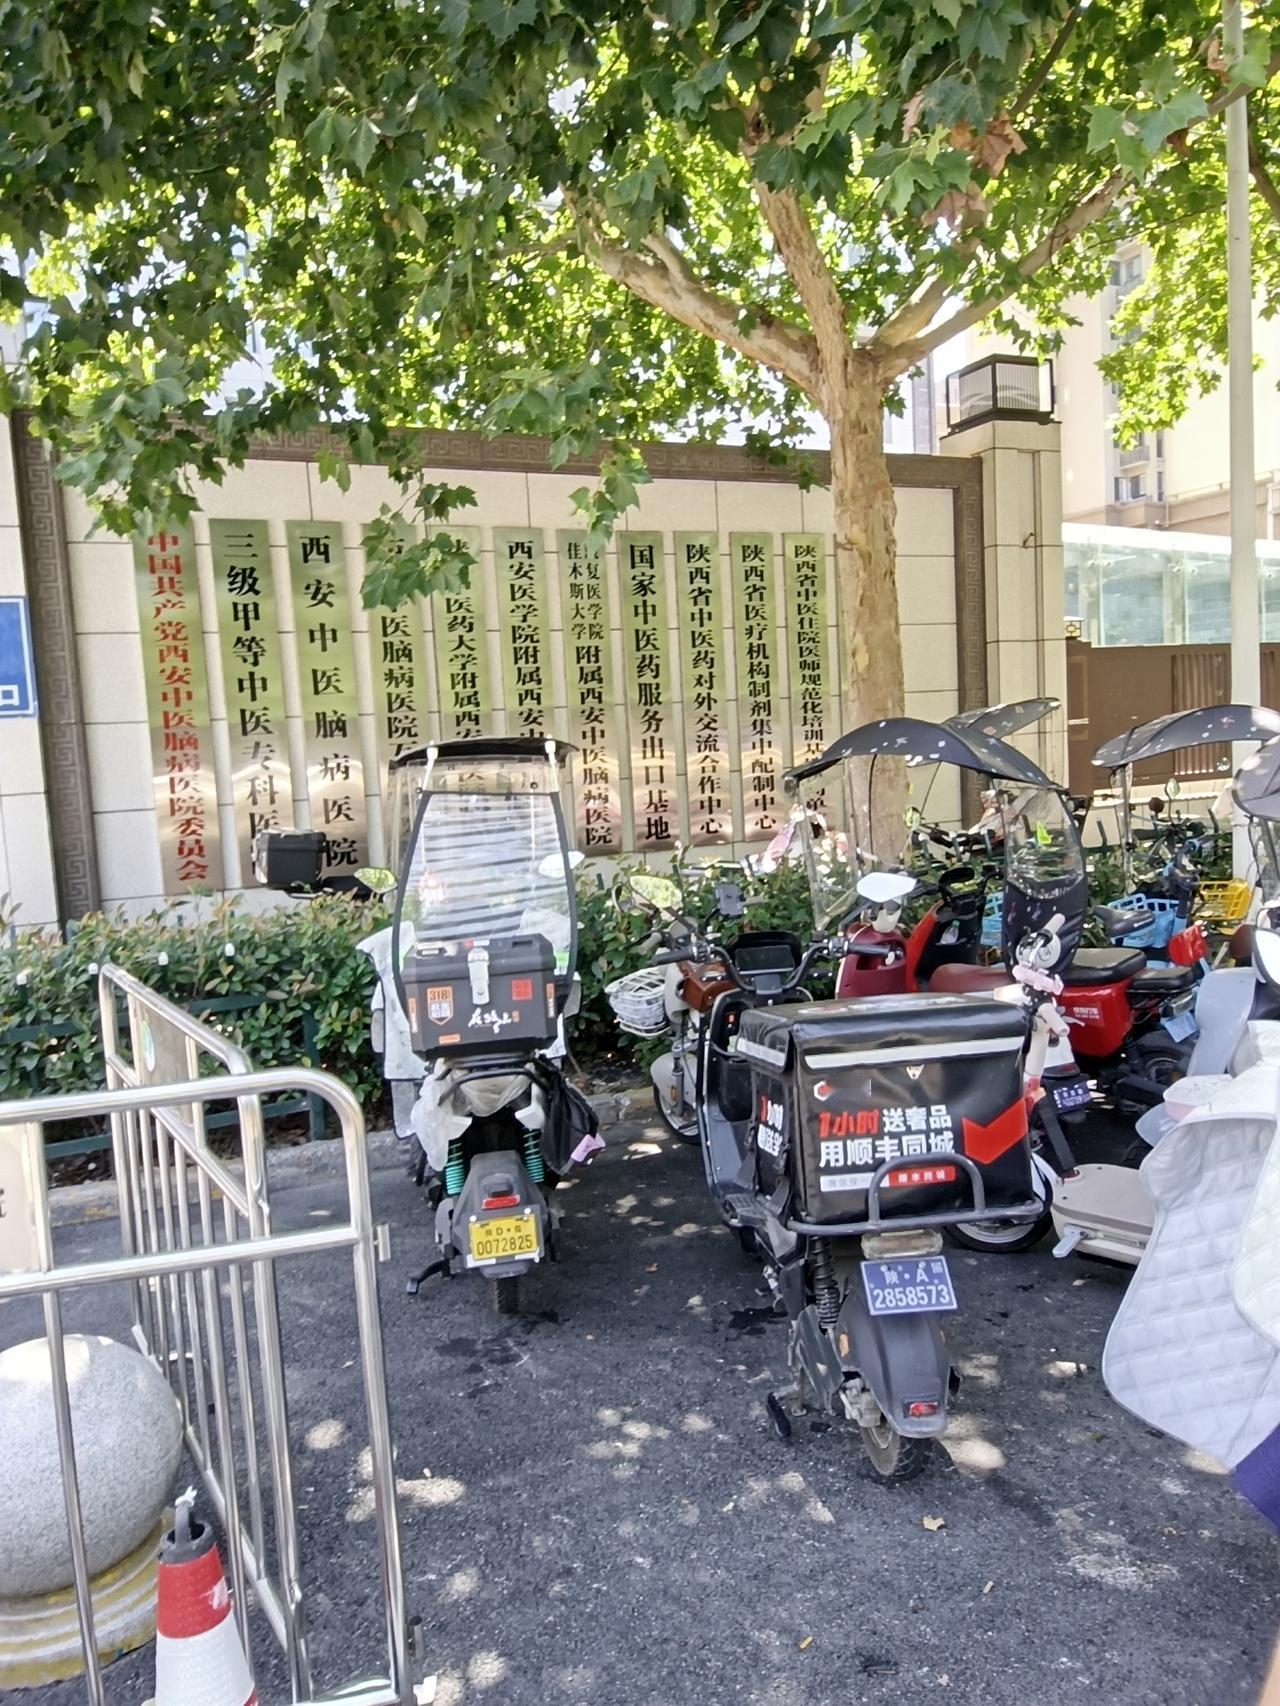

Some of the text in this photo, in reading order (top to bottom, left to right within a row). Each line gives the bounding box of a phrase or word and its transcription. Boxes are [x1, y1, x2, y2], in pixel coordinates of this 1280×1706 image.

[147, 531, 209, 881] 中国共产党西安中医脑病医院委员会
[223, 533, 281, 875] 三级甲等中医专科医
[300, 535, 359, 868] 西安中医脑病医院
[629, 544, 671, 840] 国家中医药服务出口基地
[685, 543, 723, 834] 陕西省中医药对外交流合作中心
[741, 544, 777, 830] 陕西省医疗机构制剂集中配制中心
[476, 1234, 533, 1256] 0072825
[819, 1130, 955, 1168] 用顺丰同城
[873, 1284, 950, 1309] 2858573
